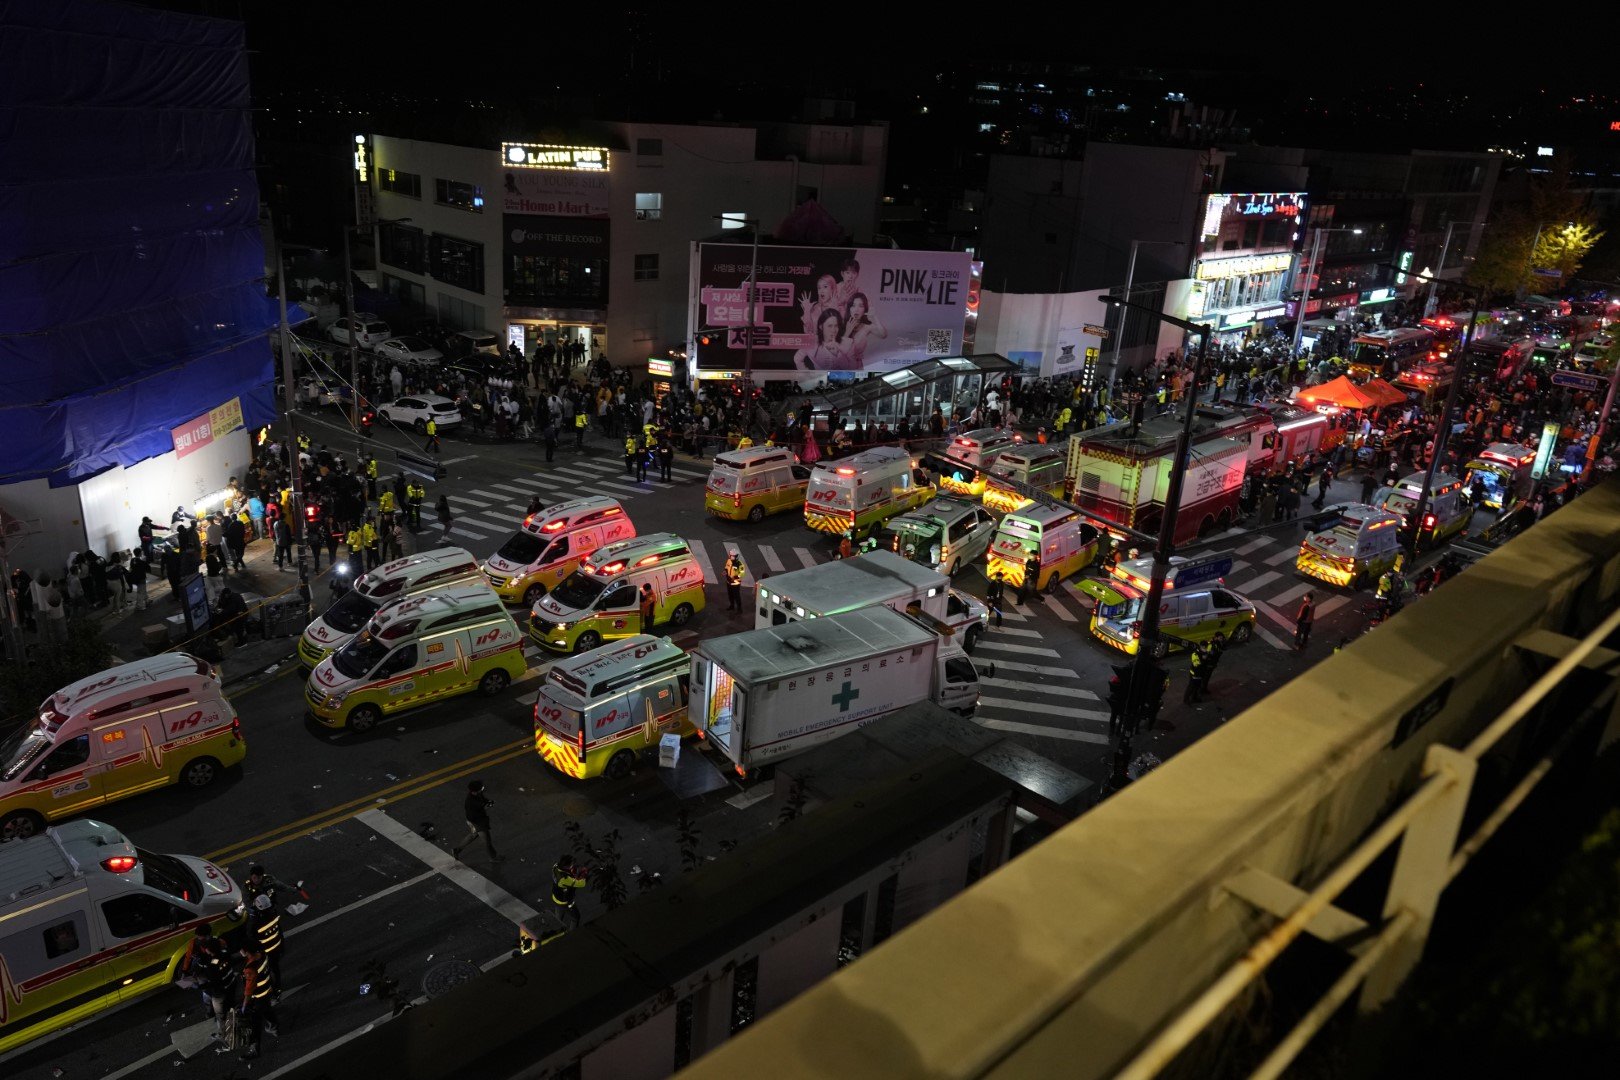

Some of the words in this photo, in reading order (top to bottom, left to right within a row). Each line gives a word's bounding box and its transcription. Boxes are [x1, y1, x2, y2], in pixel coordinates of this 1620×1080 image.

[528, 151, 571, 164] LATIN
[572, 150, 602, 162] PUB
[583, 176, 606, 189] SILK
[520, 199, 555, 212] Home
[558, 201, 590, 214] Mart
[527, 232, 544, 241] OFF
[544, 233, 564, 242] THE
[564, 234, 603, 244] RECORD
[712, 264, 736, 273] 사랑을
[764, 265, 787, 274] 하나의
[788, 265, 812, 276] 거짓말
[931, 269, 960, 279] 핑크라이
[880, 268, 927, 294] PINK
[926, 281, 958, 305] LIE
[711, 293, 720, 302] 저
[175, 432, 192, 451] 임대
[812, 490, 837, 502] 119
[606, 525, 622, 539] 119
[1315, 535, 1337, 545] 119
[670, 567, 688, 583] 119
[476, 628, 500, 646] 119
[541, 706, 562, 721] 119
[596, 709, 617, 729] 119
[777, 726, 804, 739] MOBILE
[804, 716, 846, 733] EMERGENCY
[847, 708, 877, 722] SUPPORT
[878, 702, 894, 714] UNIT
[170, 710, 202, 733] 119
